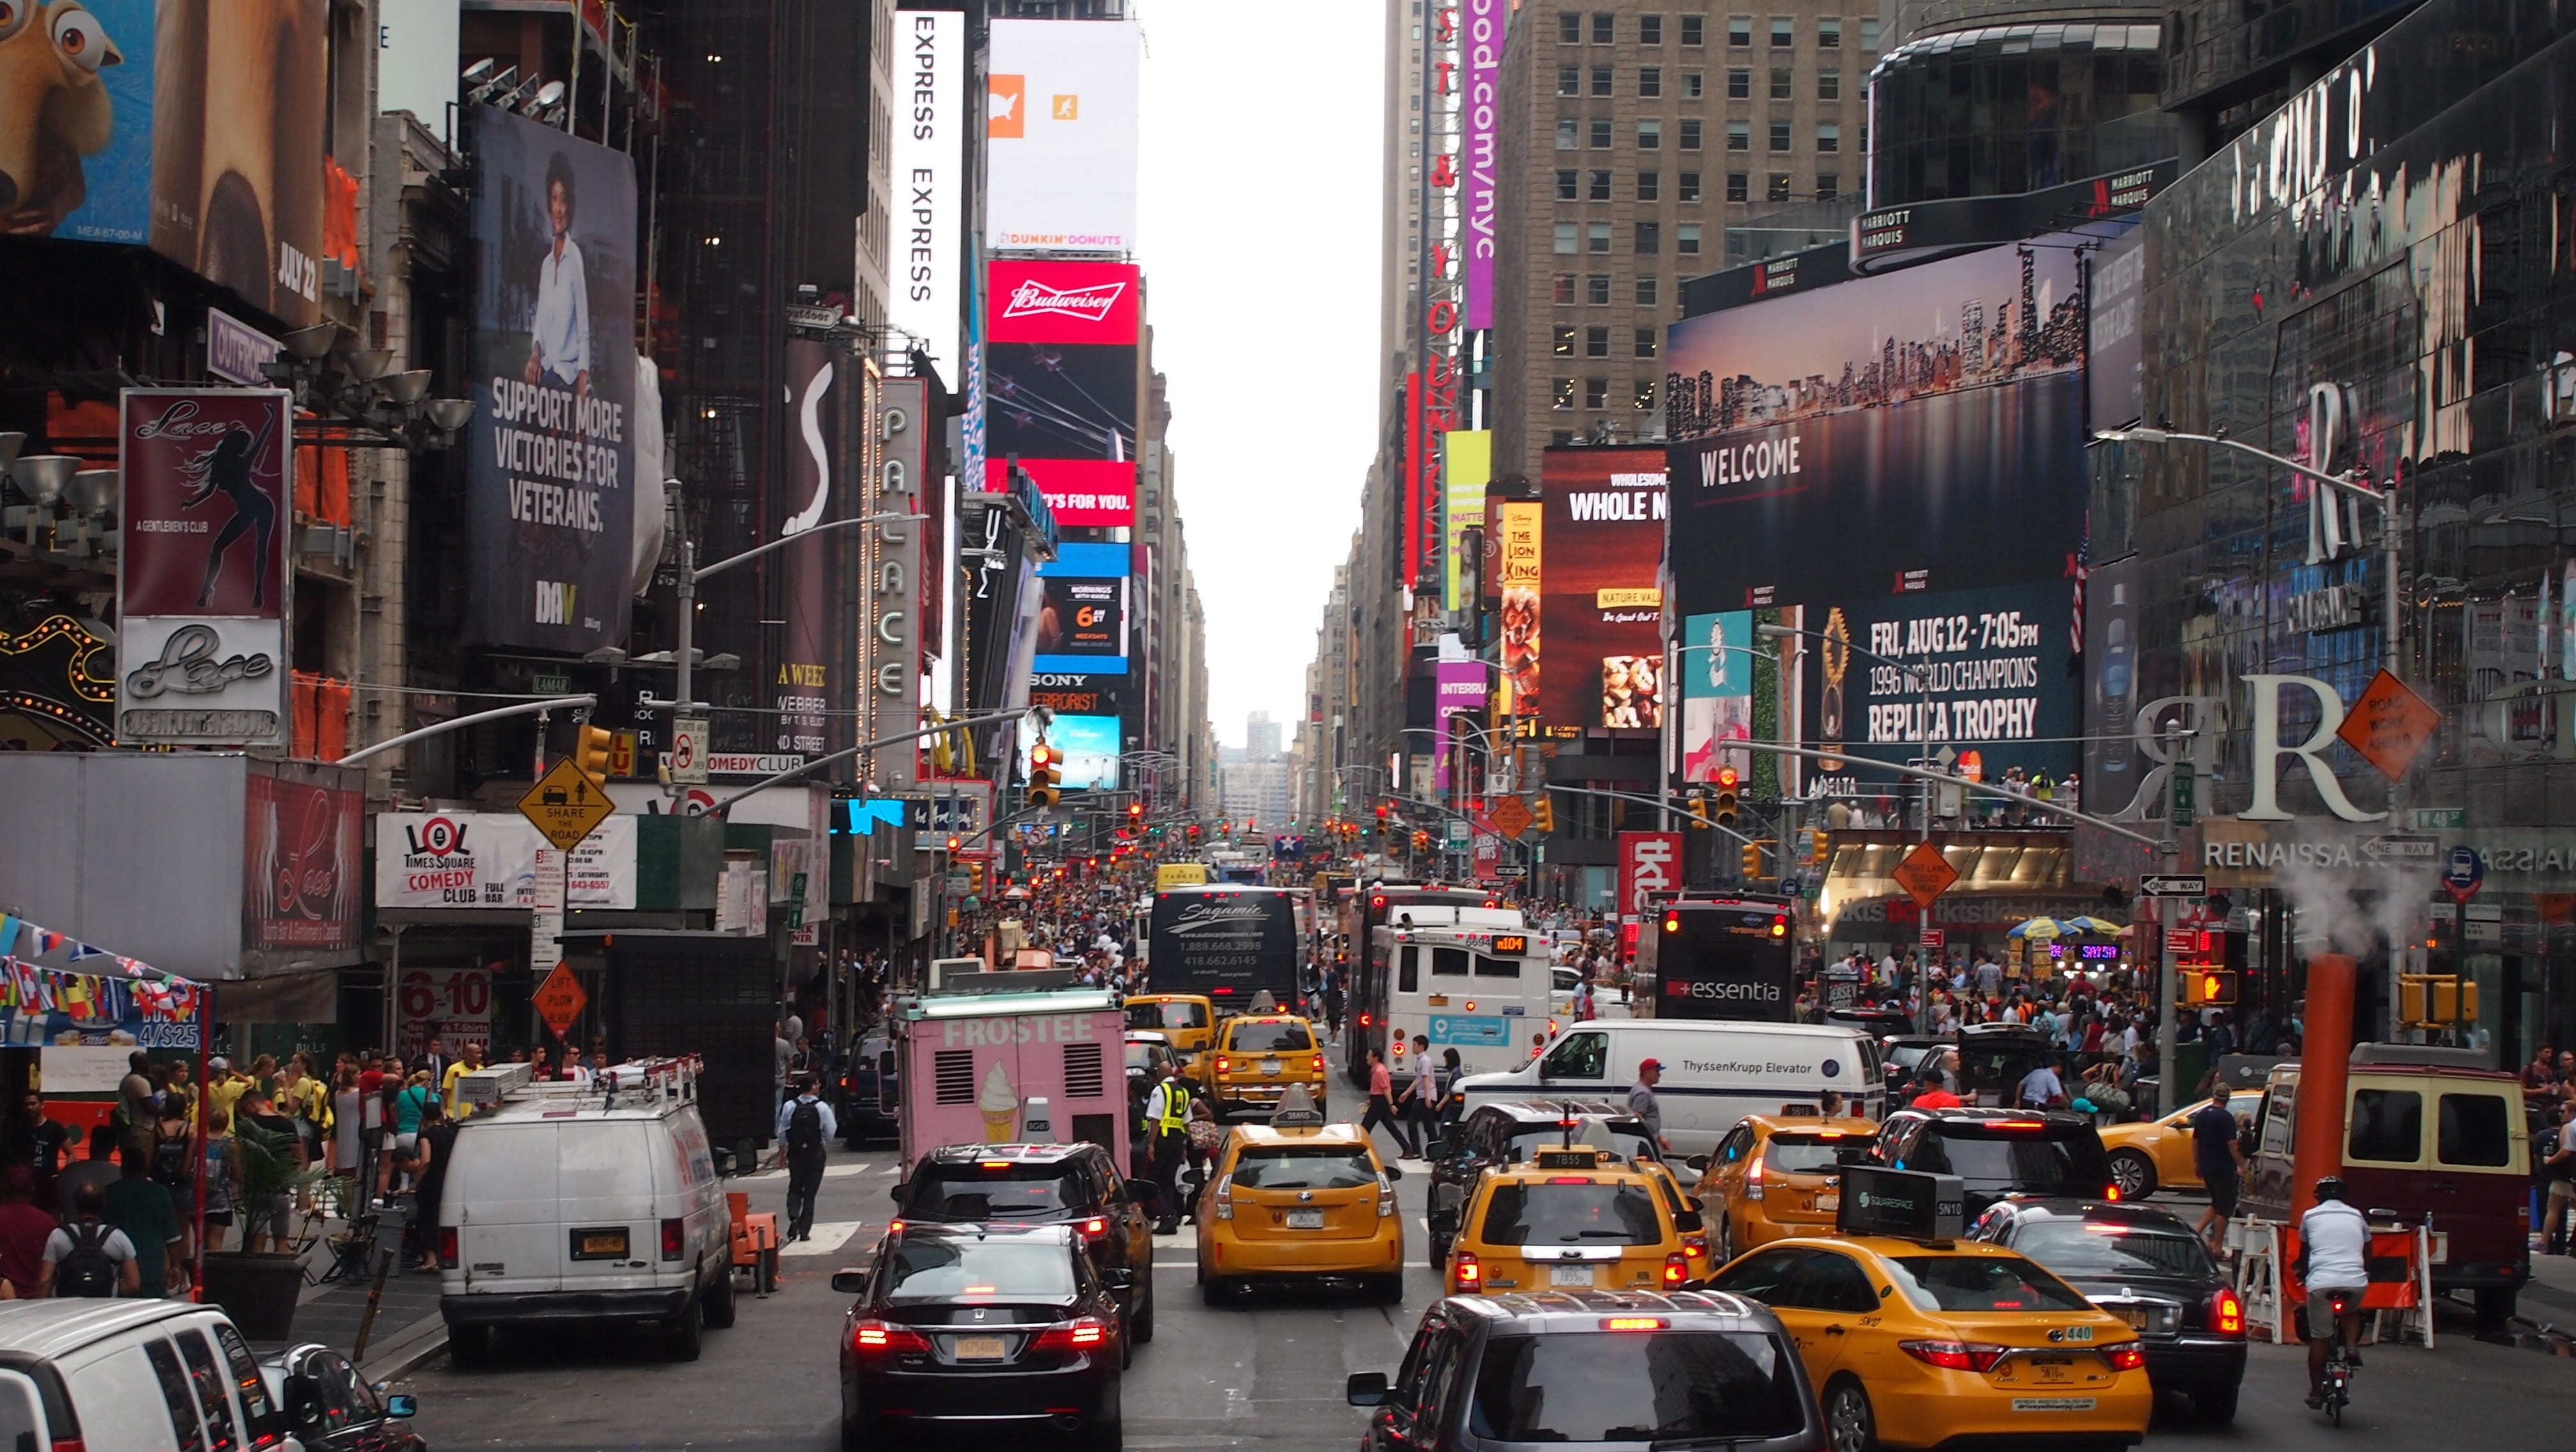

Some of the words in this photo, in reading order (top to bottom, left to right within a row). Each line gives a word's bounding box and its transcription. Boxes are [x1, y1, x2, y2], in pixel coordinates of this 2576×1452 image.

[914, 16, 935, 141] EXPRESS
[2111, 169, 2154, 191] MARRIOTT
[2111, 189, 2148, 207] MARQUIS
[1861, 210, 1911, 230] MARRIOTT
[910, 168, 933, 302] EXPRESS
[1010, 234, 1068, 245] DUNKIN'
[1068, 235, 1122, 245] DONUTS
[1860, 229, 1904, 249] MARQUIS
[279, 241, 302, 293] JULY
[303, 257, 316, 303] 22
[1767, 257, 1798, 275] MARRIOTT
[1767, 274, 1795, 290] MARQUIS
[1012, 285, 1114, 309] Budweiser
[492, 376, 572, 431] SUPPORT
[575, 394, 623, 444] MORE
[135, 400, 228, 440] Lace
[494, 425, 582, 481] VICTORIES
[585, 445, 618, 489] FOR
[1700, 435, 1801, 488] WELCOME
[509, 477, 604, 532] VETERANS.
[1068, 493, 1096, 510] FOR
[1098, 493, 1131, 511] YOU.
[1568, 491, 1647, 521] WHOLE
[135, 520, 142, 532] A
[190, 521, 208, 533] CLUB
[1511, 531, 1531, 541] THE
[877, 407, 907, 696] PALACE
[1508, 543, 1535, 559] LION
[1505, 561, 1539, 581] KING
[1071, 585, 1113, 594] MORNINGS
[1602, 592, 1638, 604] NATURE
[535, 580, 578, 626] DAV
[1076, 606, 1094, 628] 6
[1871, 620, 1905, 659] FRI,
[1906, 617, 1945, 654] AUG
[1946, 615, 1968, 651] 12
[1980, 611, 2039, 650] 7:05PM
[127, 624, 273, 700] Lace
[778, 663, 789, 685] A
[790, 664, 827, 688] WEEK
[1029, 674, 1087, 686] SONY
[1869, 666, 1901, 696] 1996
[1903, 661, 1952, 693] WORLD
[1952, 656, 2037, 691] CHAMPIONS
[535, 678, 567, 692] LAMAR
[1867, 702, 1947, 743] REPLICA
[1952, 697, 2038, 740] TROPHY
[793, 736, 825, 752] STREET
[2238, 674, 2389, 821] R
[546, 808, 585, 818] SHARE
[2419, 810, 2429, 827] W
[558, 820, 573, 828] THE
[406, 817, 471, 856] LOL
[550, 830, 581, 840] ROAD
[2367, 842, 2392, 854] ONE
[2403, 843, 2429, 854] WAY
[404, 854, 435, 869] TIMES
[436, 854, 475, 870] SQUARE
[1927, 864, 1947, 873] LANE
[409, 870, 475, 891] COMEDY
[485, 883, 505, 893] FULL
[2149, 881, 2169, 890] ONE
[2179, 881, 2201, 890] WAY
[443, 888, 477, 903] CLUB
[485, 893, 503, 903] BAR
[1466, 938, 1492, 947] 6694
[551, 977, 571, 989] LIFT
[401, 971, 435, 1018] 6
[444, 971, 489, 1015] 10
[138, 1023, 199, 1048] 4/$25
[944, 1013, 1093, 1048] FROSTEE
[296, 1042, 326, 1054] BILLS
[1682, 1060, 1764, 1076] ThyssenKrupp
[1765, 1061, 1812, 1074] Elevator
[1870, 1196, 1913, 1210] SQUARESPACE
[1938, 1203, 1962, 1216] 5N10
[2067, 1326, 2092, 1340] 440
